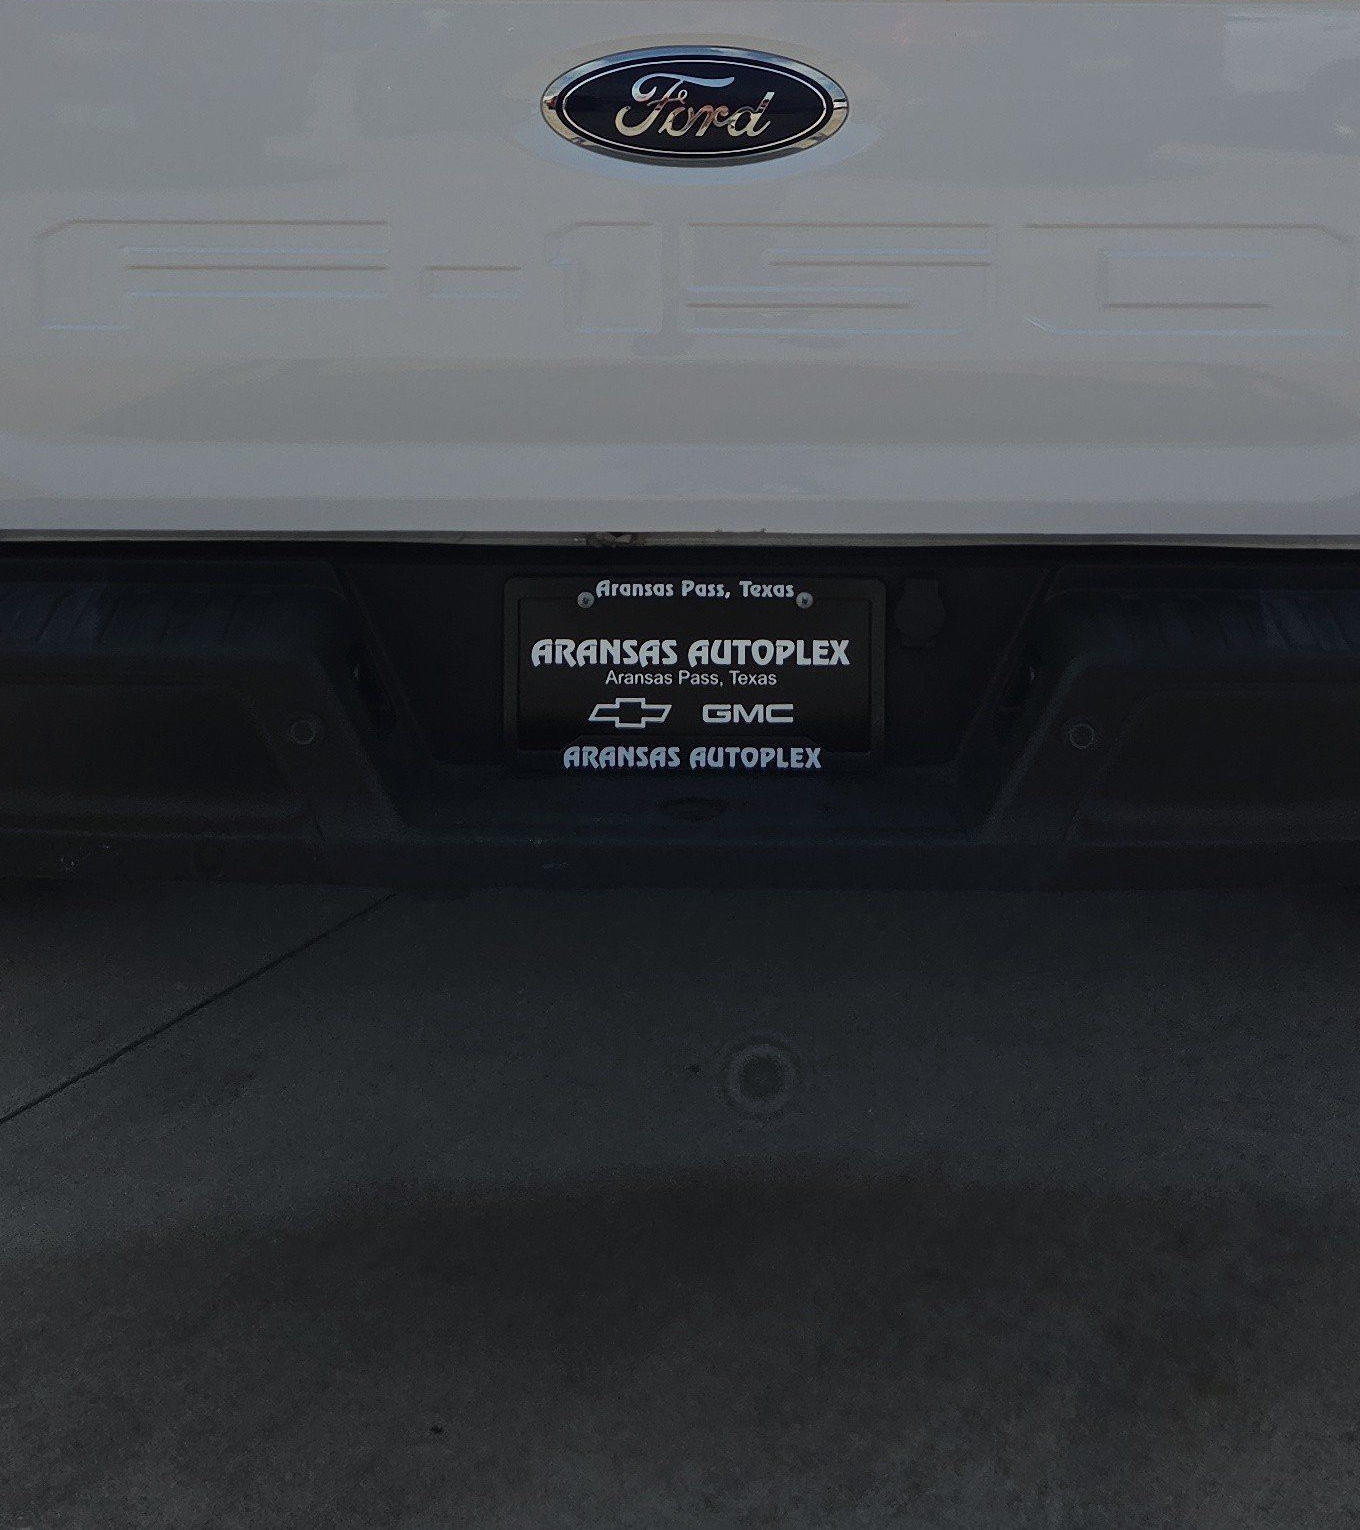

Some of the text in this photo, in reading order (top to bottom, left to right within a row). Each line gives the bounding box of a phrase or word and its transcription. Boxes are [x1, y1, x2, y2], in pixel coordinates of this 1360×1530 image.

[614, 72, 775, 137] Ford
[595, 579, 794, 600] Aransas Pass, Texas
[531, 638, 851, 668] ARANSAS AUTOPLEX
[605, 670, 777, 687] Aransas Pass, Texas
[702, 703, 794, 723] GMC
[563, 745, 822, 769] ARANSAS AUTOPLEX
